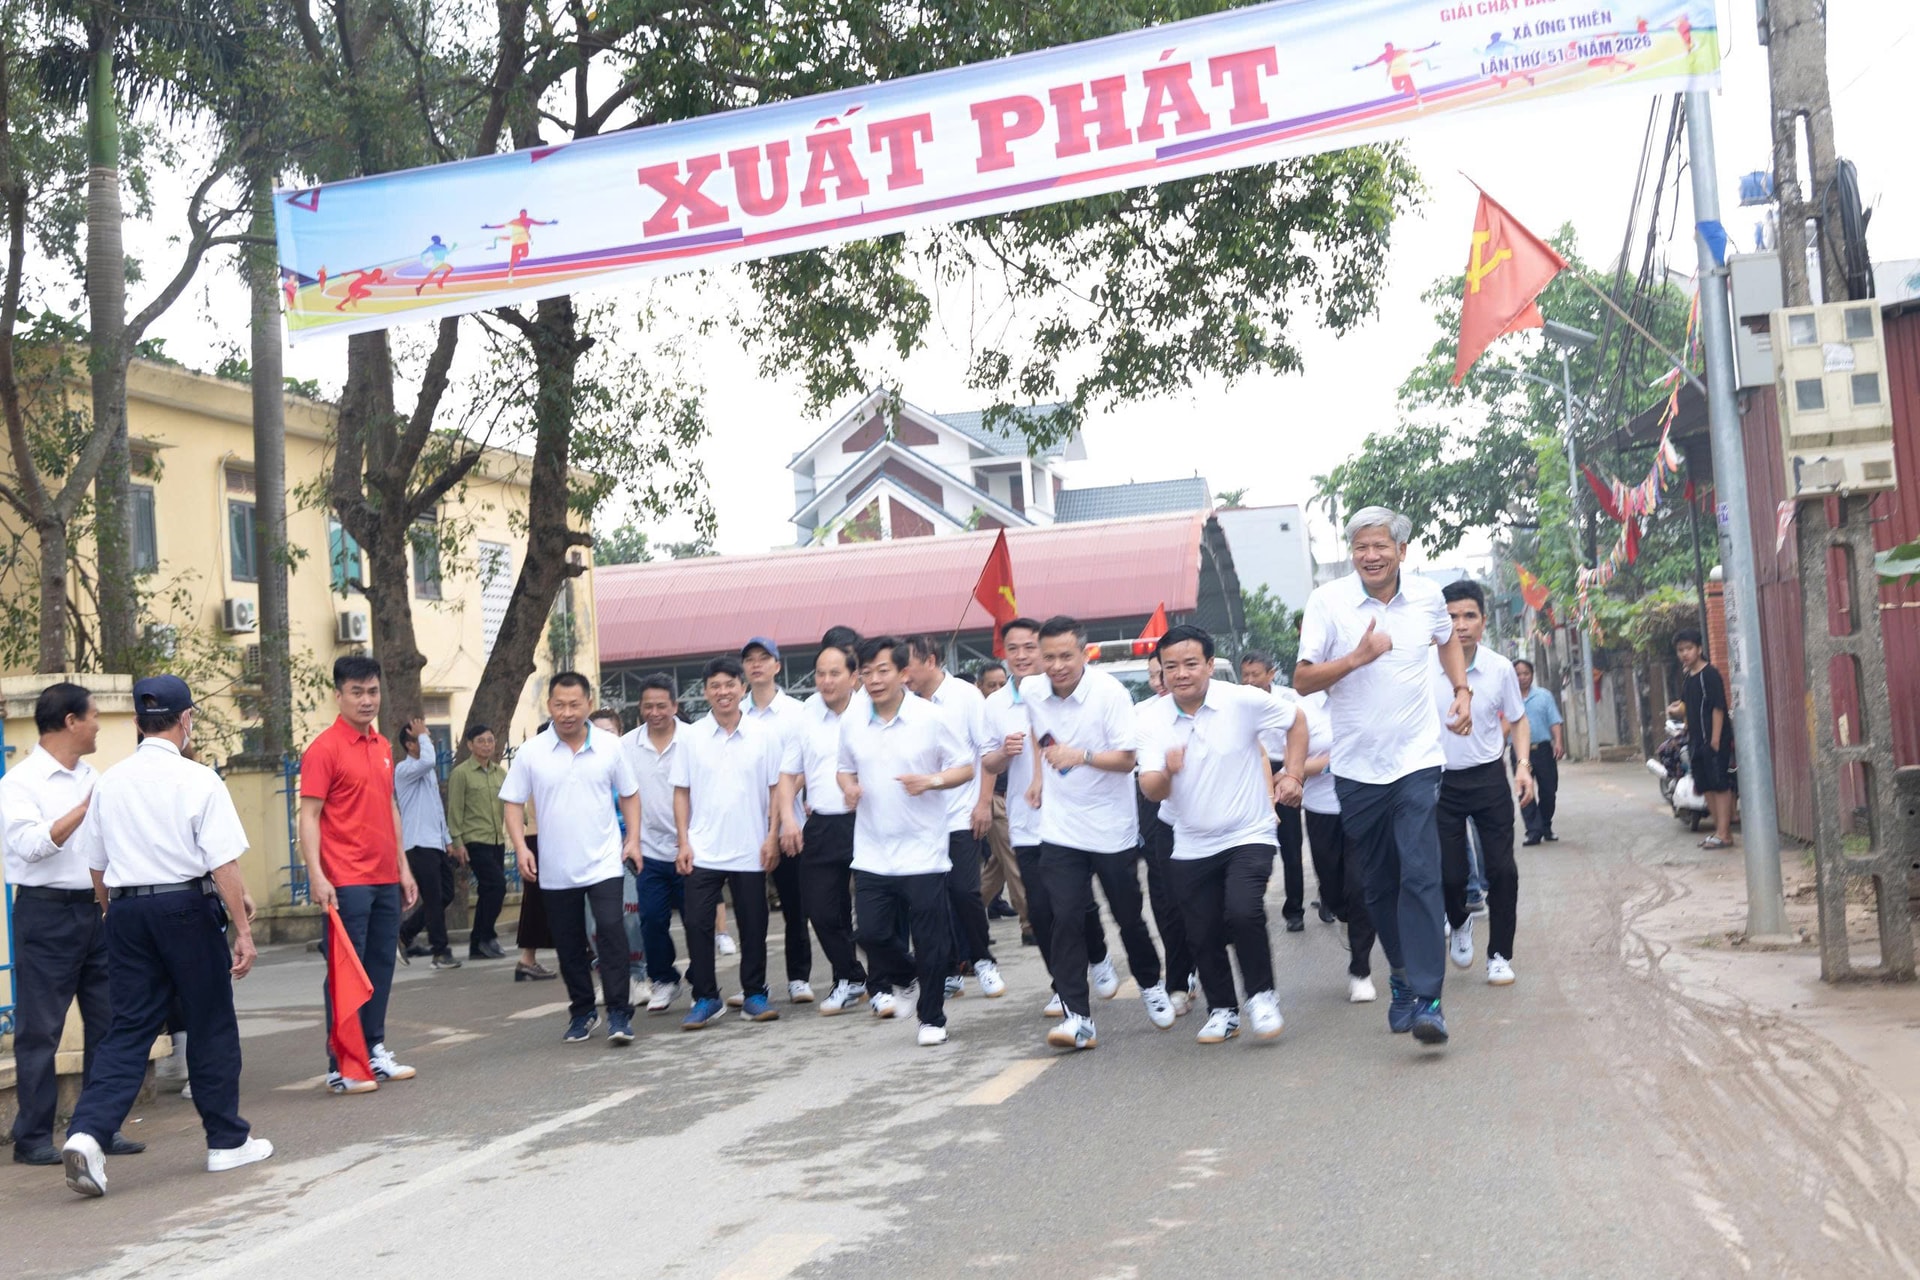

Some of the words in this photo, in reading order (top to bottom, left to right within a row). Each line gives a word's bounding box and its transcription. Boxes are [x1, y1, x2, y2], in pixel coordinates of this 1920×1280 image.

[1548, 49, 1564, 63] 51
[1577, 39, 1613, 59] NĂM
[637, 105, 934, 238] XUẤT
[970, 46, 1279, 174] PHÁT
